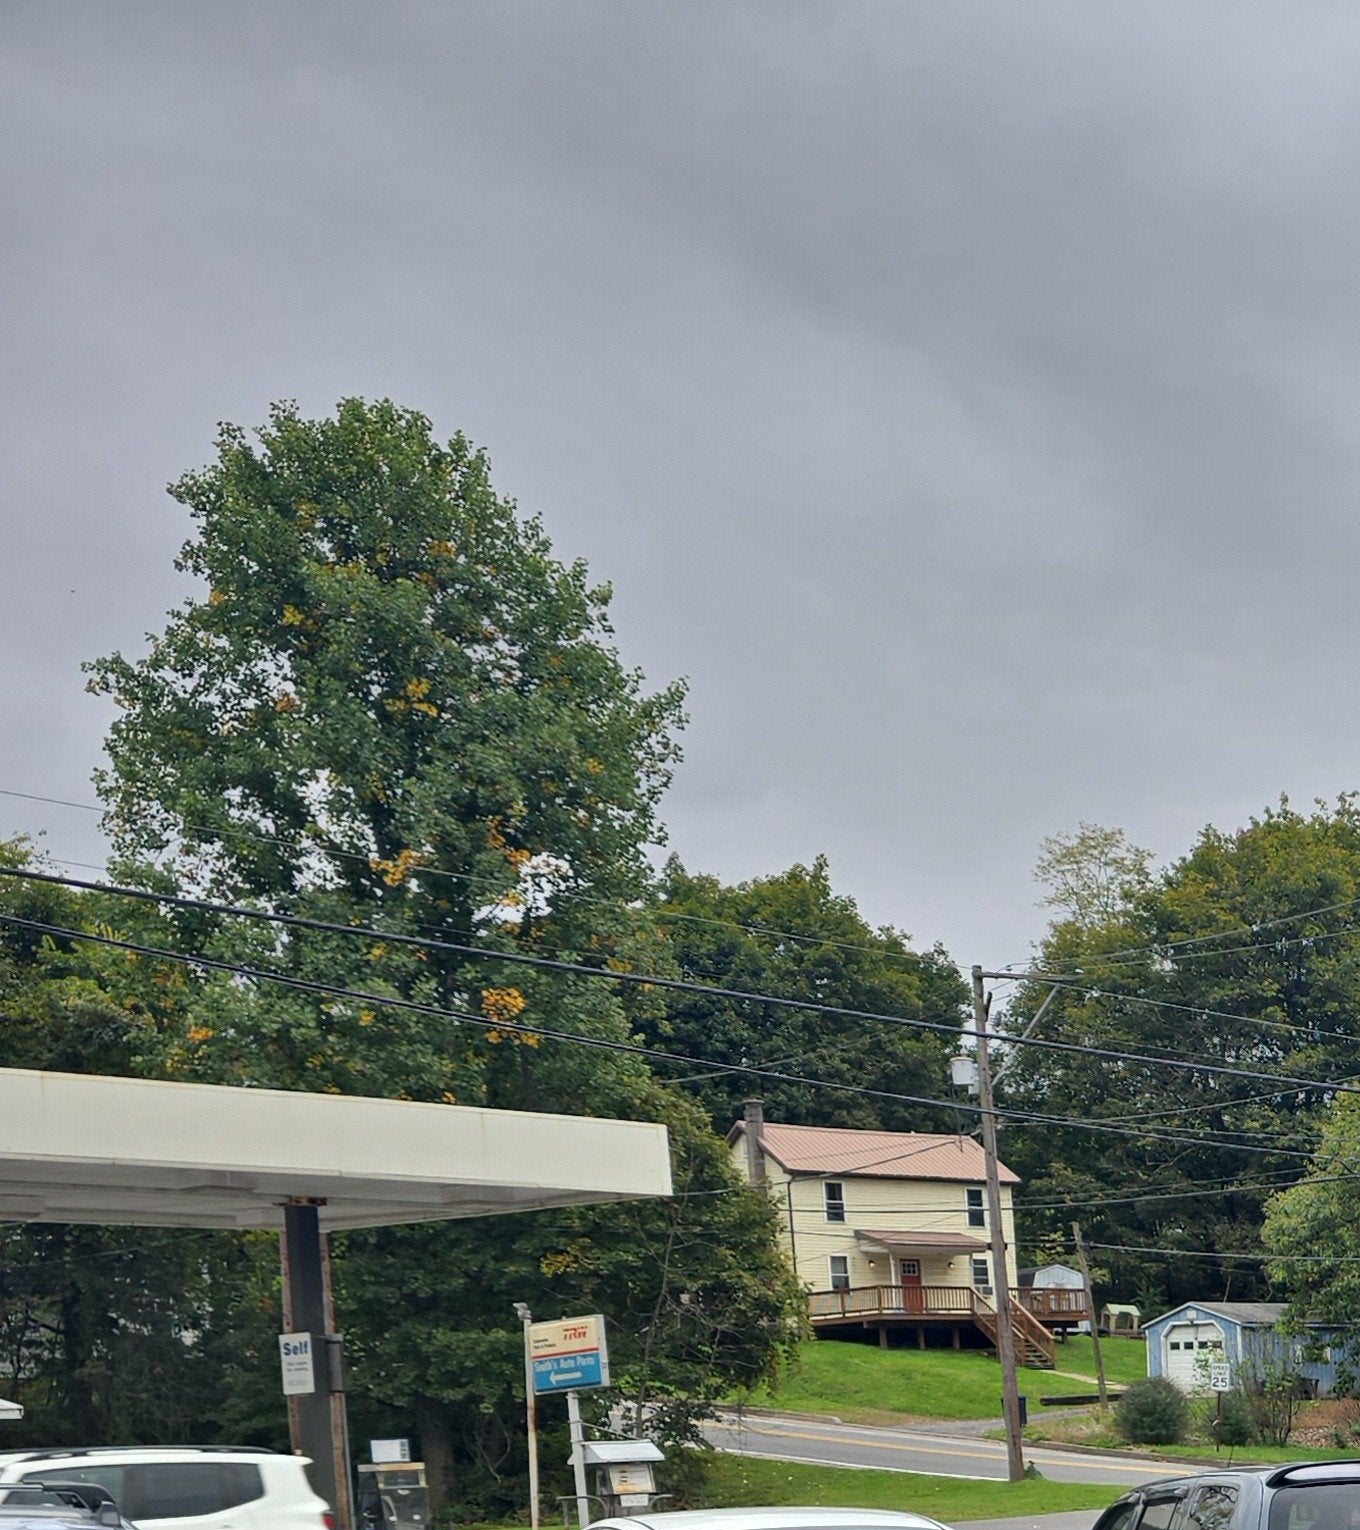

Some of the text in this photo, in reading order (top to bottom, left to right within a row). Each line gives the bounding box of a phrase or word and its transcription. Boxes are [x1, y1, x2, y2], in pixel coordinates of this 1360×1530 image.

[283, 1341, 308, 1356] Self
[560, 1358, 575, 1369] Auto
[1213, 1377, 1228, 1387] 25
